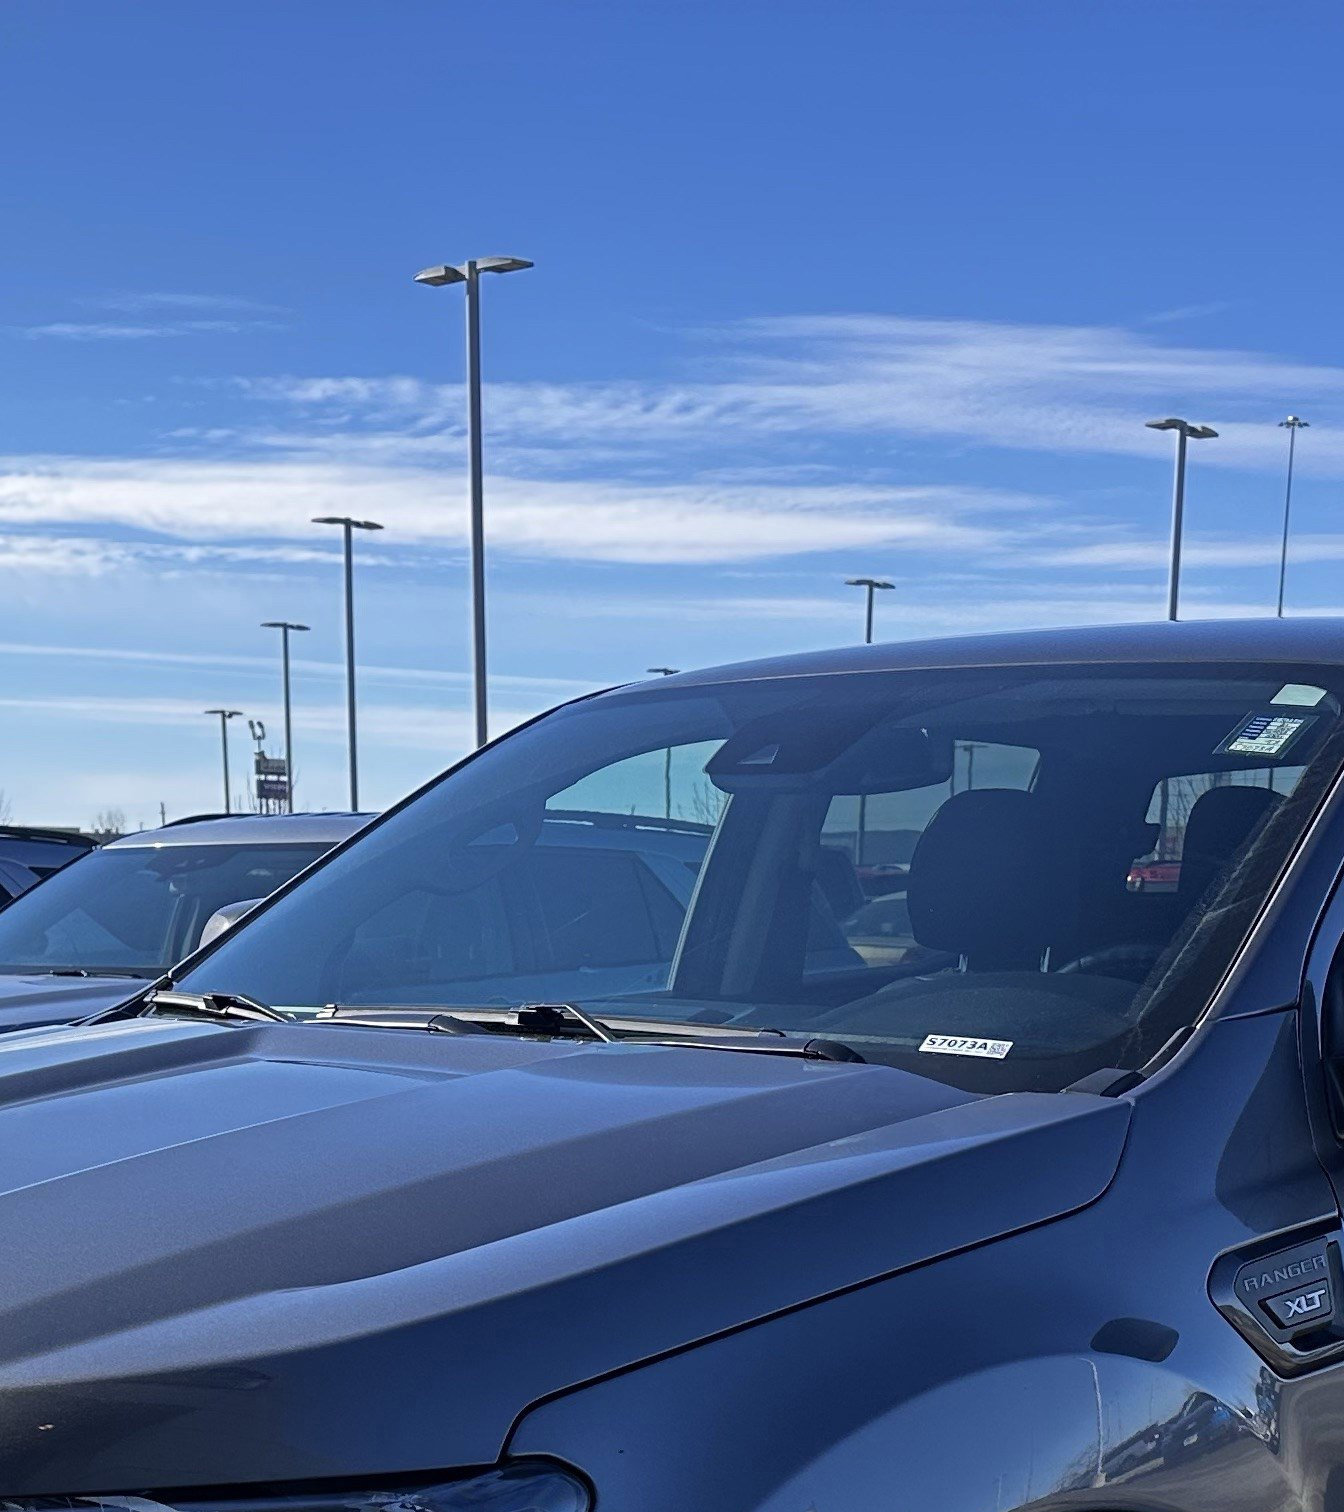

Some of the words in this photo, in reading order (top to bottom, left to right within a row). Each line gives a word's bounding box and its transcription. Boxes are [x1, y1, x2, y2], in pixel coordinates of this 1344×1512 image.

[926, 1037, 988, 1051] S7073A
[1243, 1254, 1328, 1292] RANGER
[1284, 1289, 1326, 1319] XLT
